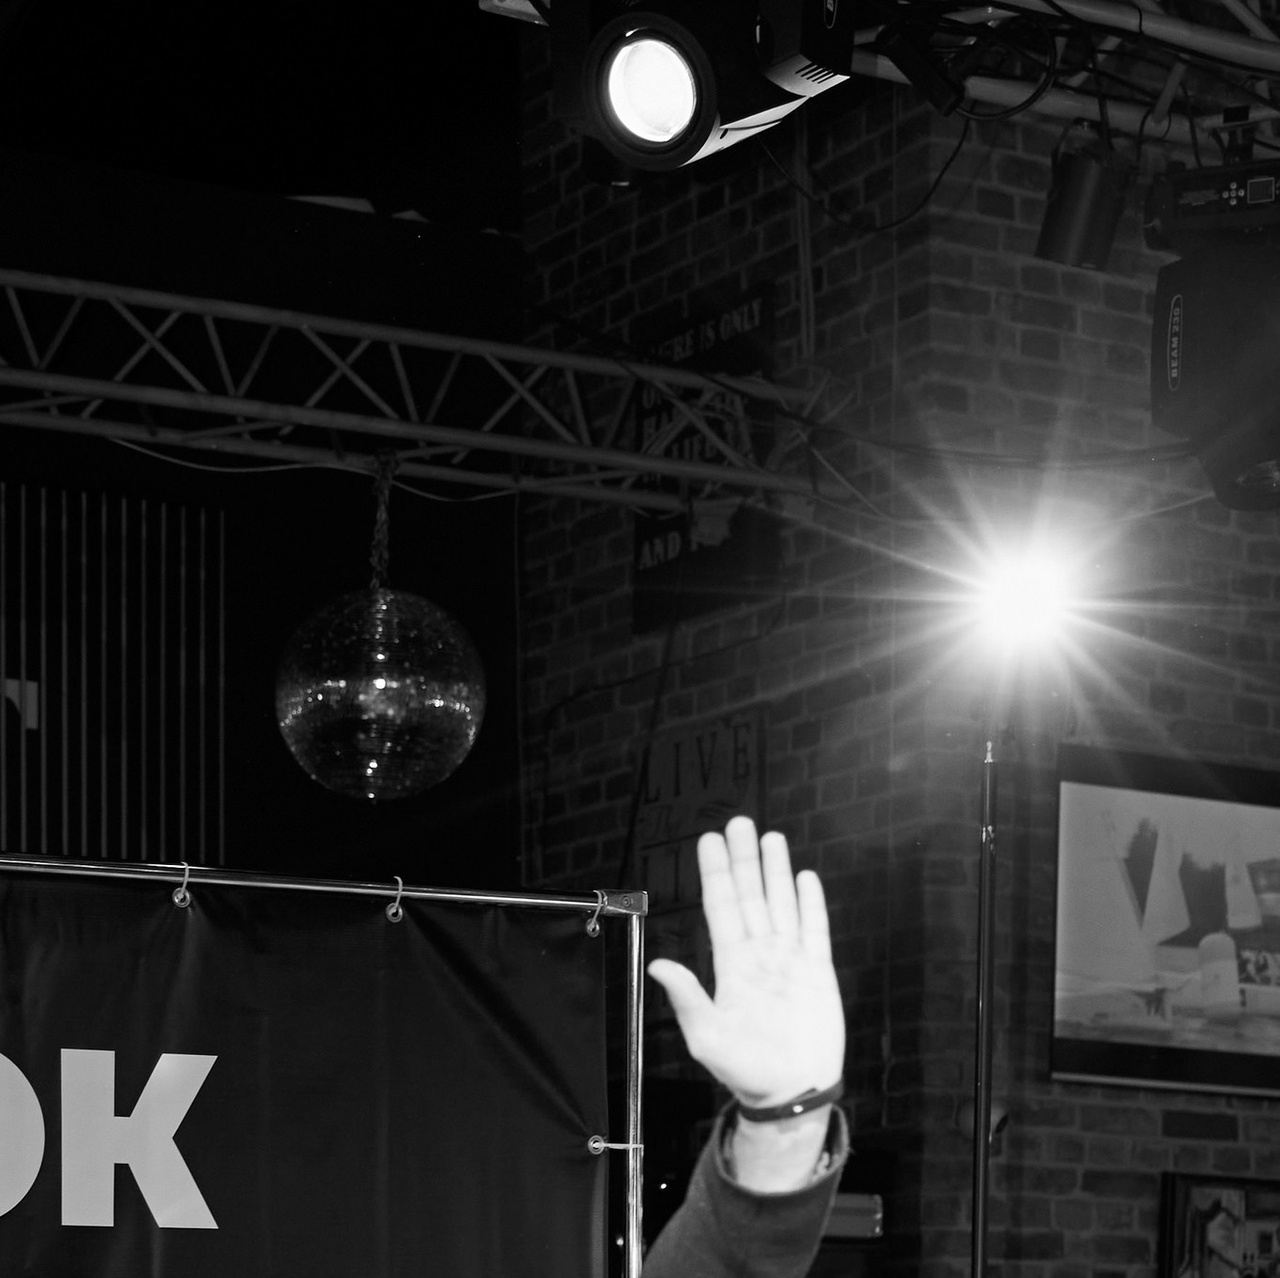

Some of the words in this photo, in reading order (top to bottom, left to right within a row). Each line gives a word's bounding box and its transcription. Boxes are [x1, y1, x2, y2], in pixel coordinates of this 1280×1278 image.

[1172, 308, 1180, 333] 230
[1171, 337, 1179, 378] BEAM
[638, 531, 682, 571] AND
[642, 721, 752, 805] LIVE
